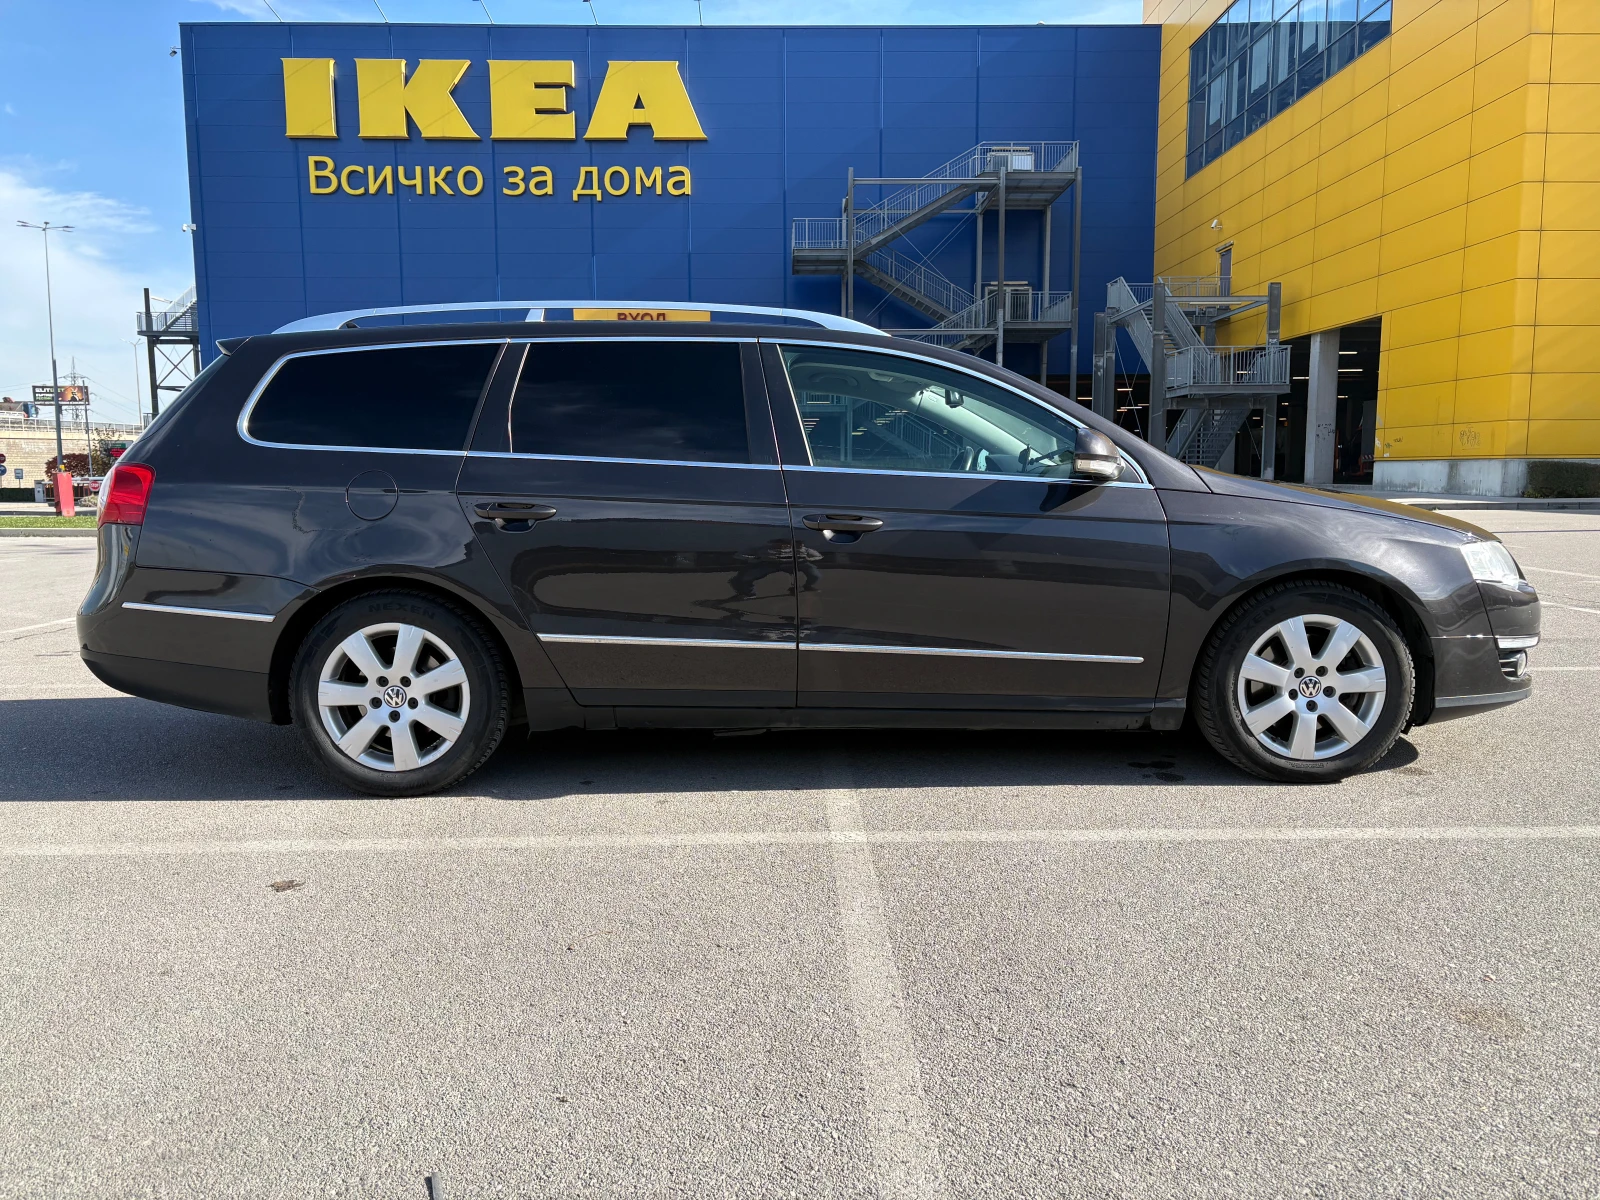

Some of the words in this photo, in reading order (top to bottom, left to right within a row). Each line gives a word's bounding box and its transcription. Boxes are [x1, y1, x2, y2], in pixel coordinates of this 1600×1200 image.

[280, 57, 708, 140] IKEA
[307, 155, 485, 197] Всичко
[502, 165, 554, 197] за
[572, 165, 692, 203] дома
[367, 601, 436, 619] NEXEN
